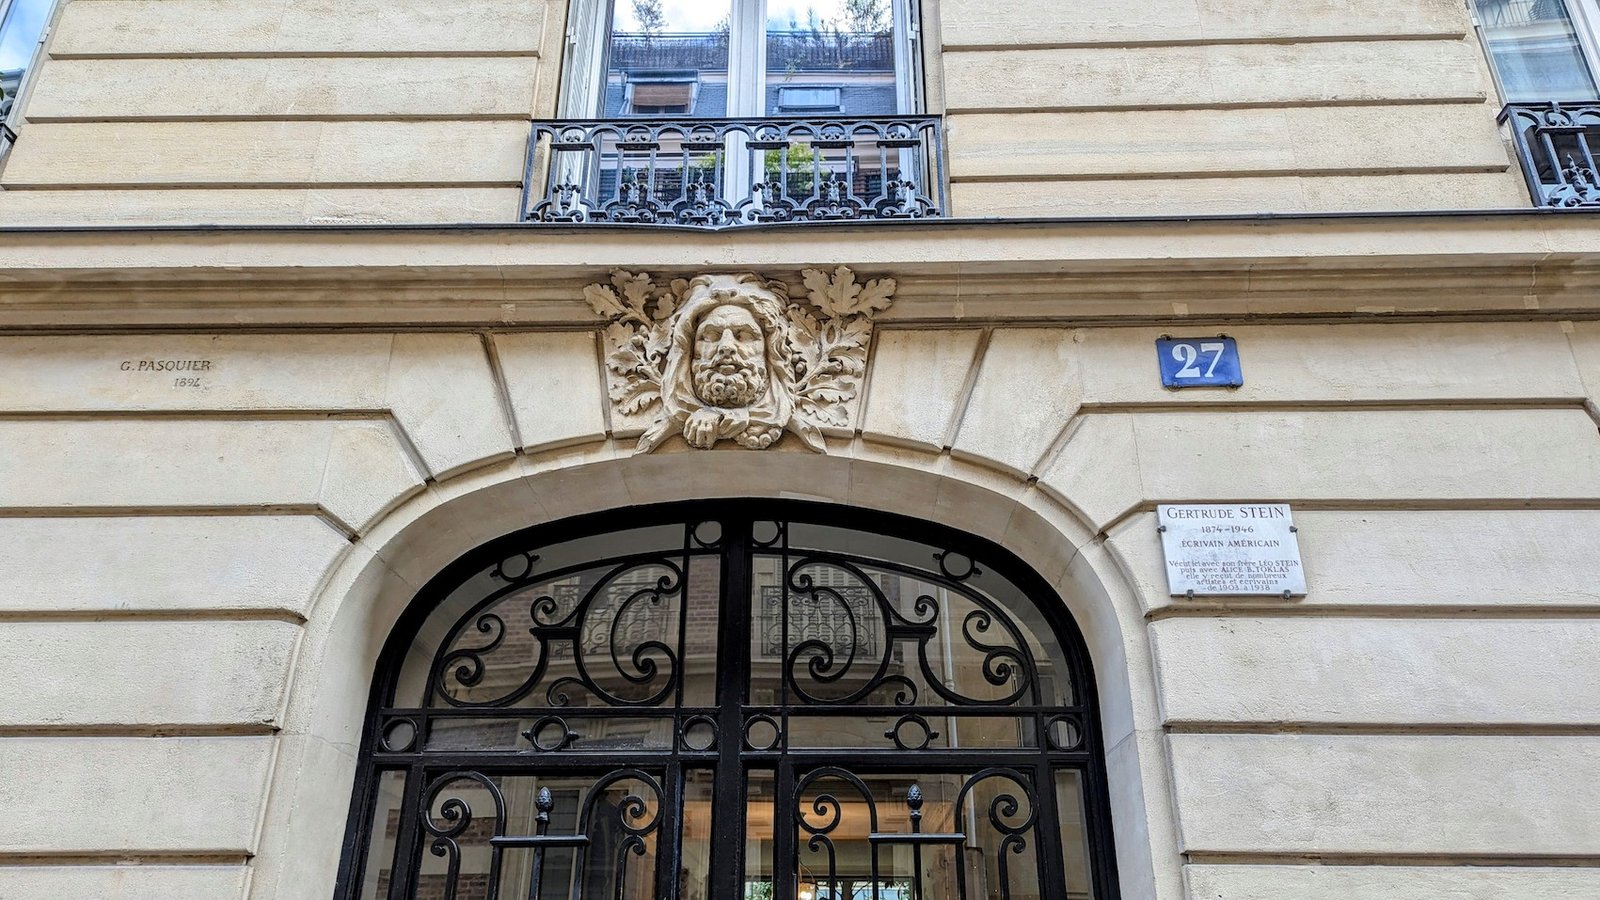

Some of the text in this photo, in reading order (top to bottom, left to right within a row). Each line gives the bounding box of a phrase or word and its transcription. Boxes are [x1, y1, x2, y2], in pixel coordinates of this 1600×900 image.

[120, 360, 211, 372] G. PASQUIER
[1171, 342, 1225, 378] 27
[1166, 506, 1285, 519] GERTRUDE STEIN
[1181, 538, 1280, 548] ÉCRIVAIN AMÉRICAIN
[1259, 559, 1274, 567] LÉO
